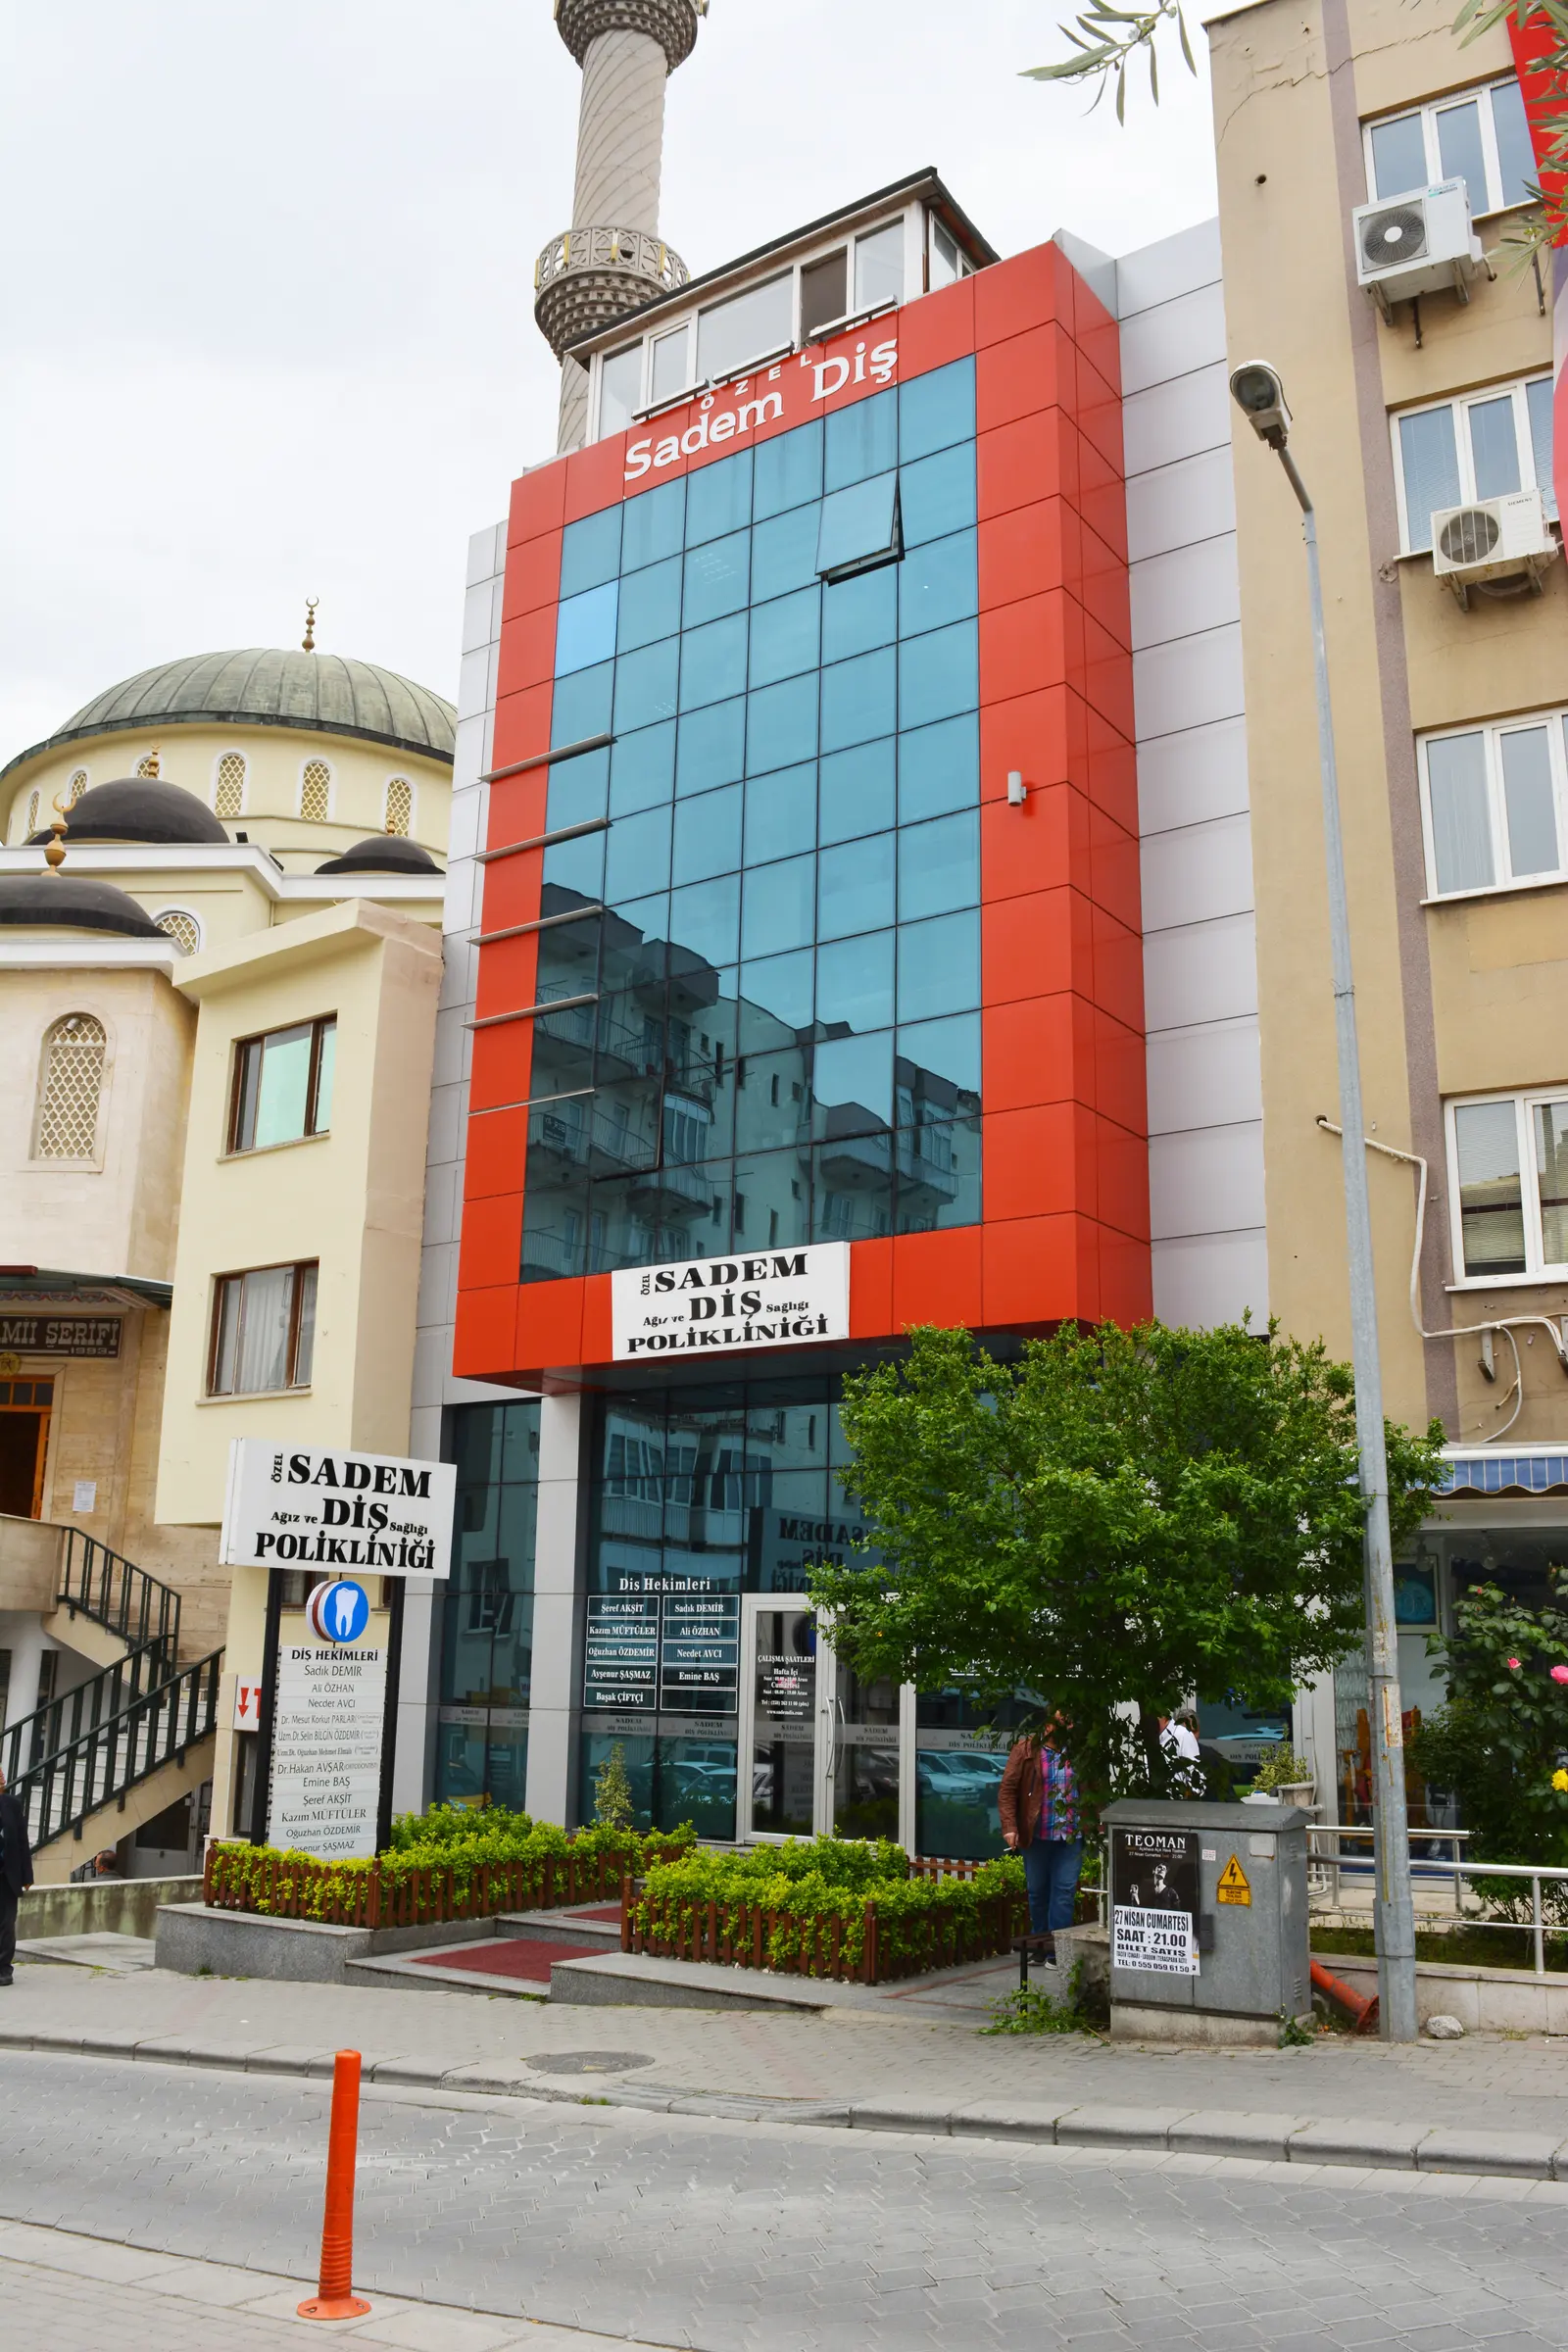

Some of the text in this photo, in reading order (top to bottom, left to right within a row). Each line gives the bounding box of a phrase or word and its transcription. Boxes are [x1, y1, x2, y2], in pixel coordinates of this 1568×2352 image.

[701, 355, 811, 410] ÖZEL
[624, 338, 898, 481] Sadem Diş
[1507, 497, 1533, 506] SIEMENS
[655, 1253, 808, 1293] SADEM
[640, 1274, 651, 1296] ÖZEL
[671, 1313, 684, 1323] ve
[689, 1289, 761, 1321] DİŞ
[766, 1300, 809, 1314] Sağlığı
[0, 1318, 120, 1348] Mİİ ŞERİFİ
[627, 1313, 829, 1353] POLİKLİNİĞİ
[271, 1453, 283, 1483] ÖZEL
[287, 1454, 432, 1498] SADEM
[270, 1494, 428, 1537] Ağız ve DİŞ Sağlığı
[254, 1530, 436, 1570] POLİKLİNİĞİ
[619, 1577, 710, 1592] Diş Hekimleri
[601, 1601, 644, 1614] Şeref AKŞİT
[696, 1601, 723, 1612] DEMİR
[589, 1624, 656, 1635] Kazım MÜFTÜLER
[680, 1625, 720, 1636] Ali ÖZHAN
[291, 1647, 378, 1661] DİŞ HEKİMLERİ
[588, 1645, 655, 1657] Oğuzhan ÖZDEMİR
[677, 1649, 722, 1658] Necdet AVCI
[758, 1654, 784, 1663] ÇALIŞMA
[304, 1665, 362, 1677] Sadık DEMİR
[591, 1669, 651, 1681] Ayşenur ŞAŞMAZ
[679, 1672, 719, 1683] Emine BAŞ
[312, 1683, 354, 1692] Ali ÖZHAN
[596, 1691, 643, 1704] Başak ÇİFTÇİ
[292, 1715, 310, 1724] Mesut
[311, 1715, 330, 1724] Korkut
[334, 1728, 361, 1740] ÖZDEMİR
[963, 1740, 1007, 1750] POLİKLİİĞİ
[317, 1762, 344, 1774] AVŞAR
[303, 1777, 351, 1788] Emine BAŞ
[303, 1792, 352, 1806] Şeref AKŞİT
[281, 1808, 367, 1823] Kazım MÜFTÜLER
[286, 1824, 361, 1839] Oğuzhan ÖZDEMİR
[322, 1840, 355, 1853] ŞAŞMAZ
[1125, 1834, 1186, 1849] TEOMAN
[1114, 1908, 1189, 1932] 27 NİSAN CUMARTESİ
[1117, 1928, 1145, 1943] SAAT
[1153, 1932, 1187, 1947] 21.00
[1117, 1942, 1148, 1952] BİLET
[1151, 1947, 1186, 1957] SATIŞ
